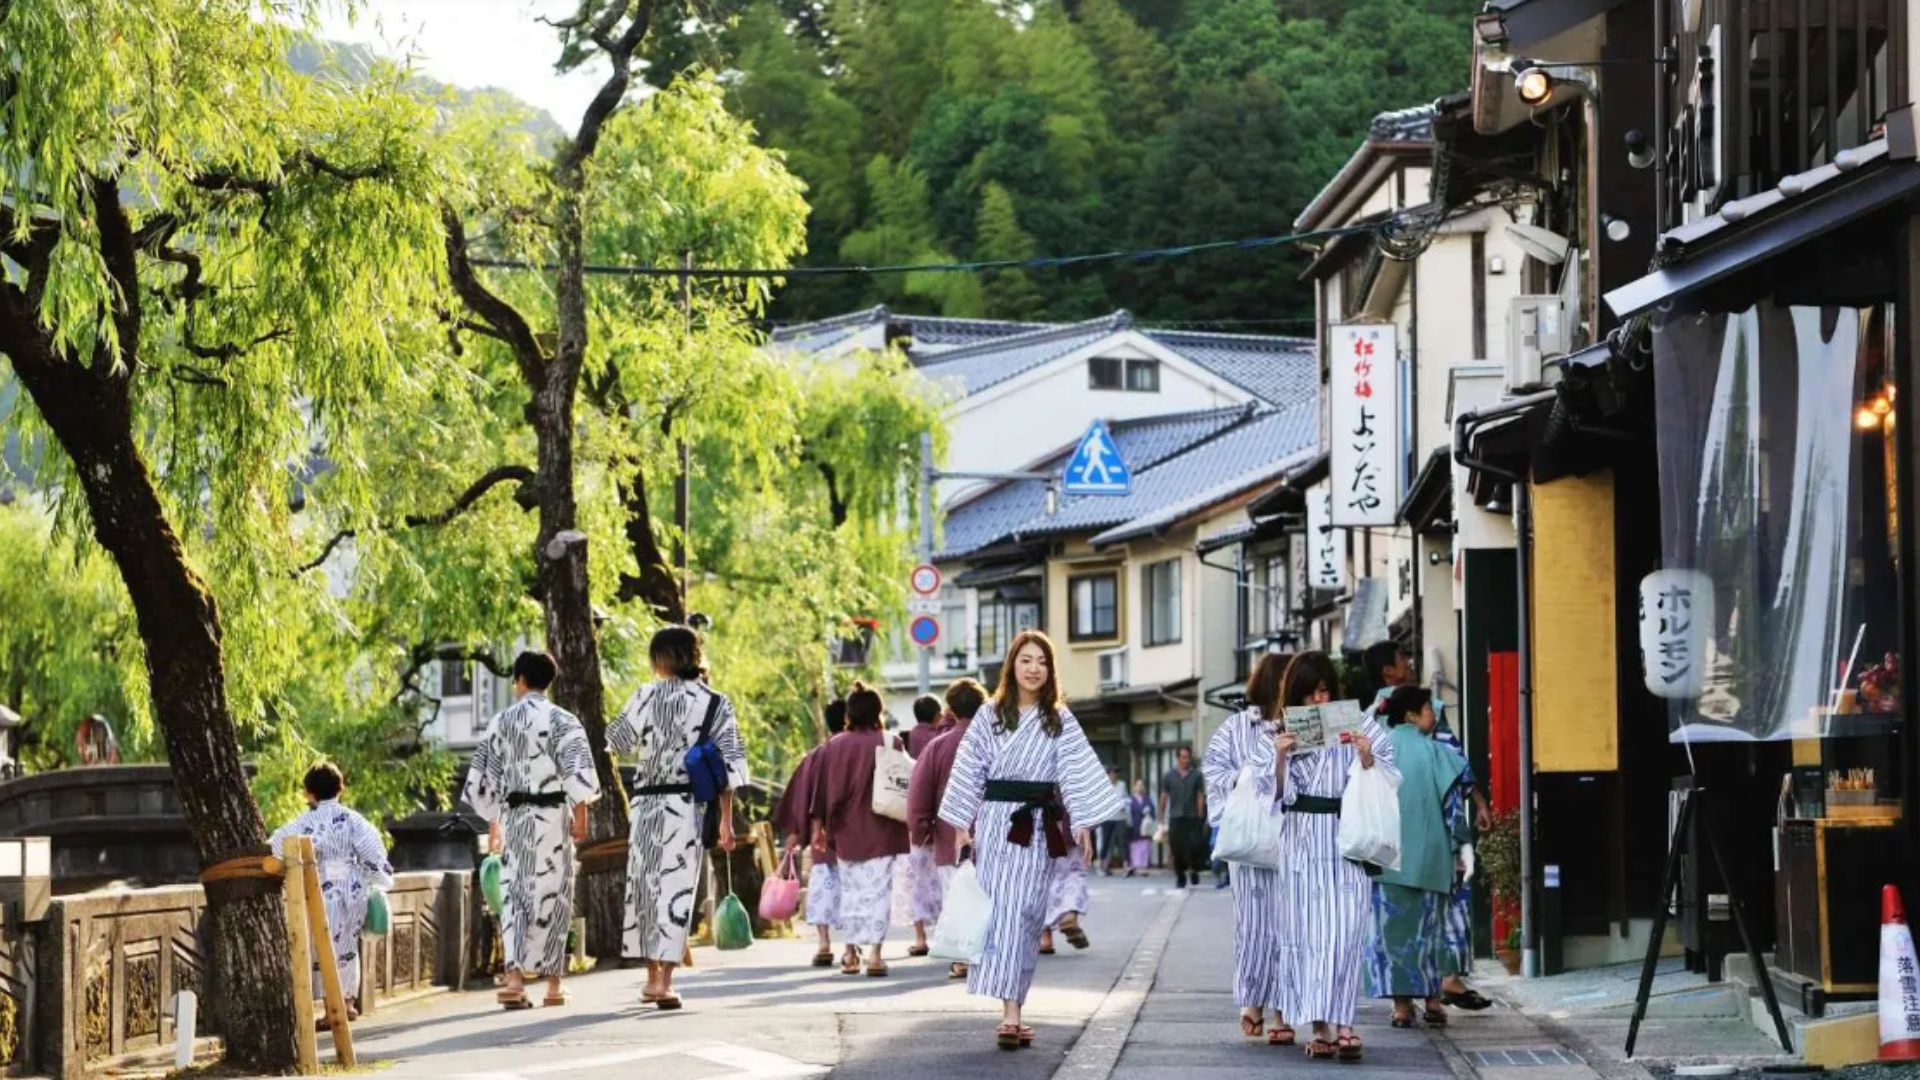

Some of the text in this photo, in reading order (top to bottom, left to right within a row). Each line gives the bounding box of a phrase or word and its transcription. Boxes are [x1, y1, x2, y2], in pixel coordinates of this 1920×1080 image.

[1354, 337, 1374, 398] 松竹梅
[1348, 405, 1381, 516] よいだや
[1657, 584, 1691, 684] ホルモン
